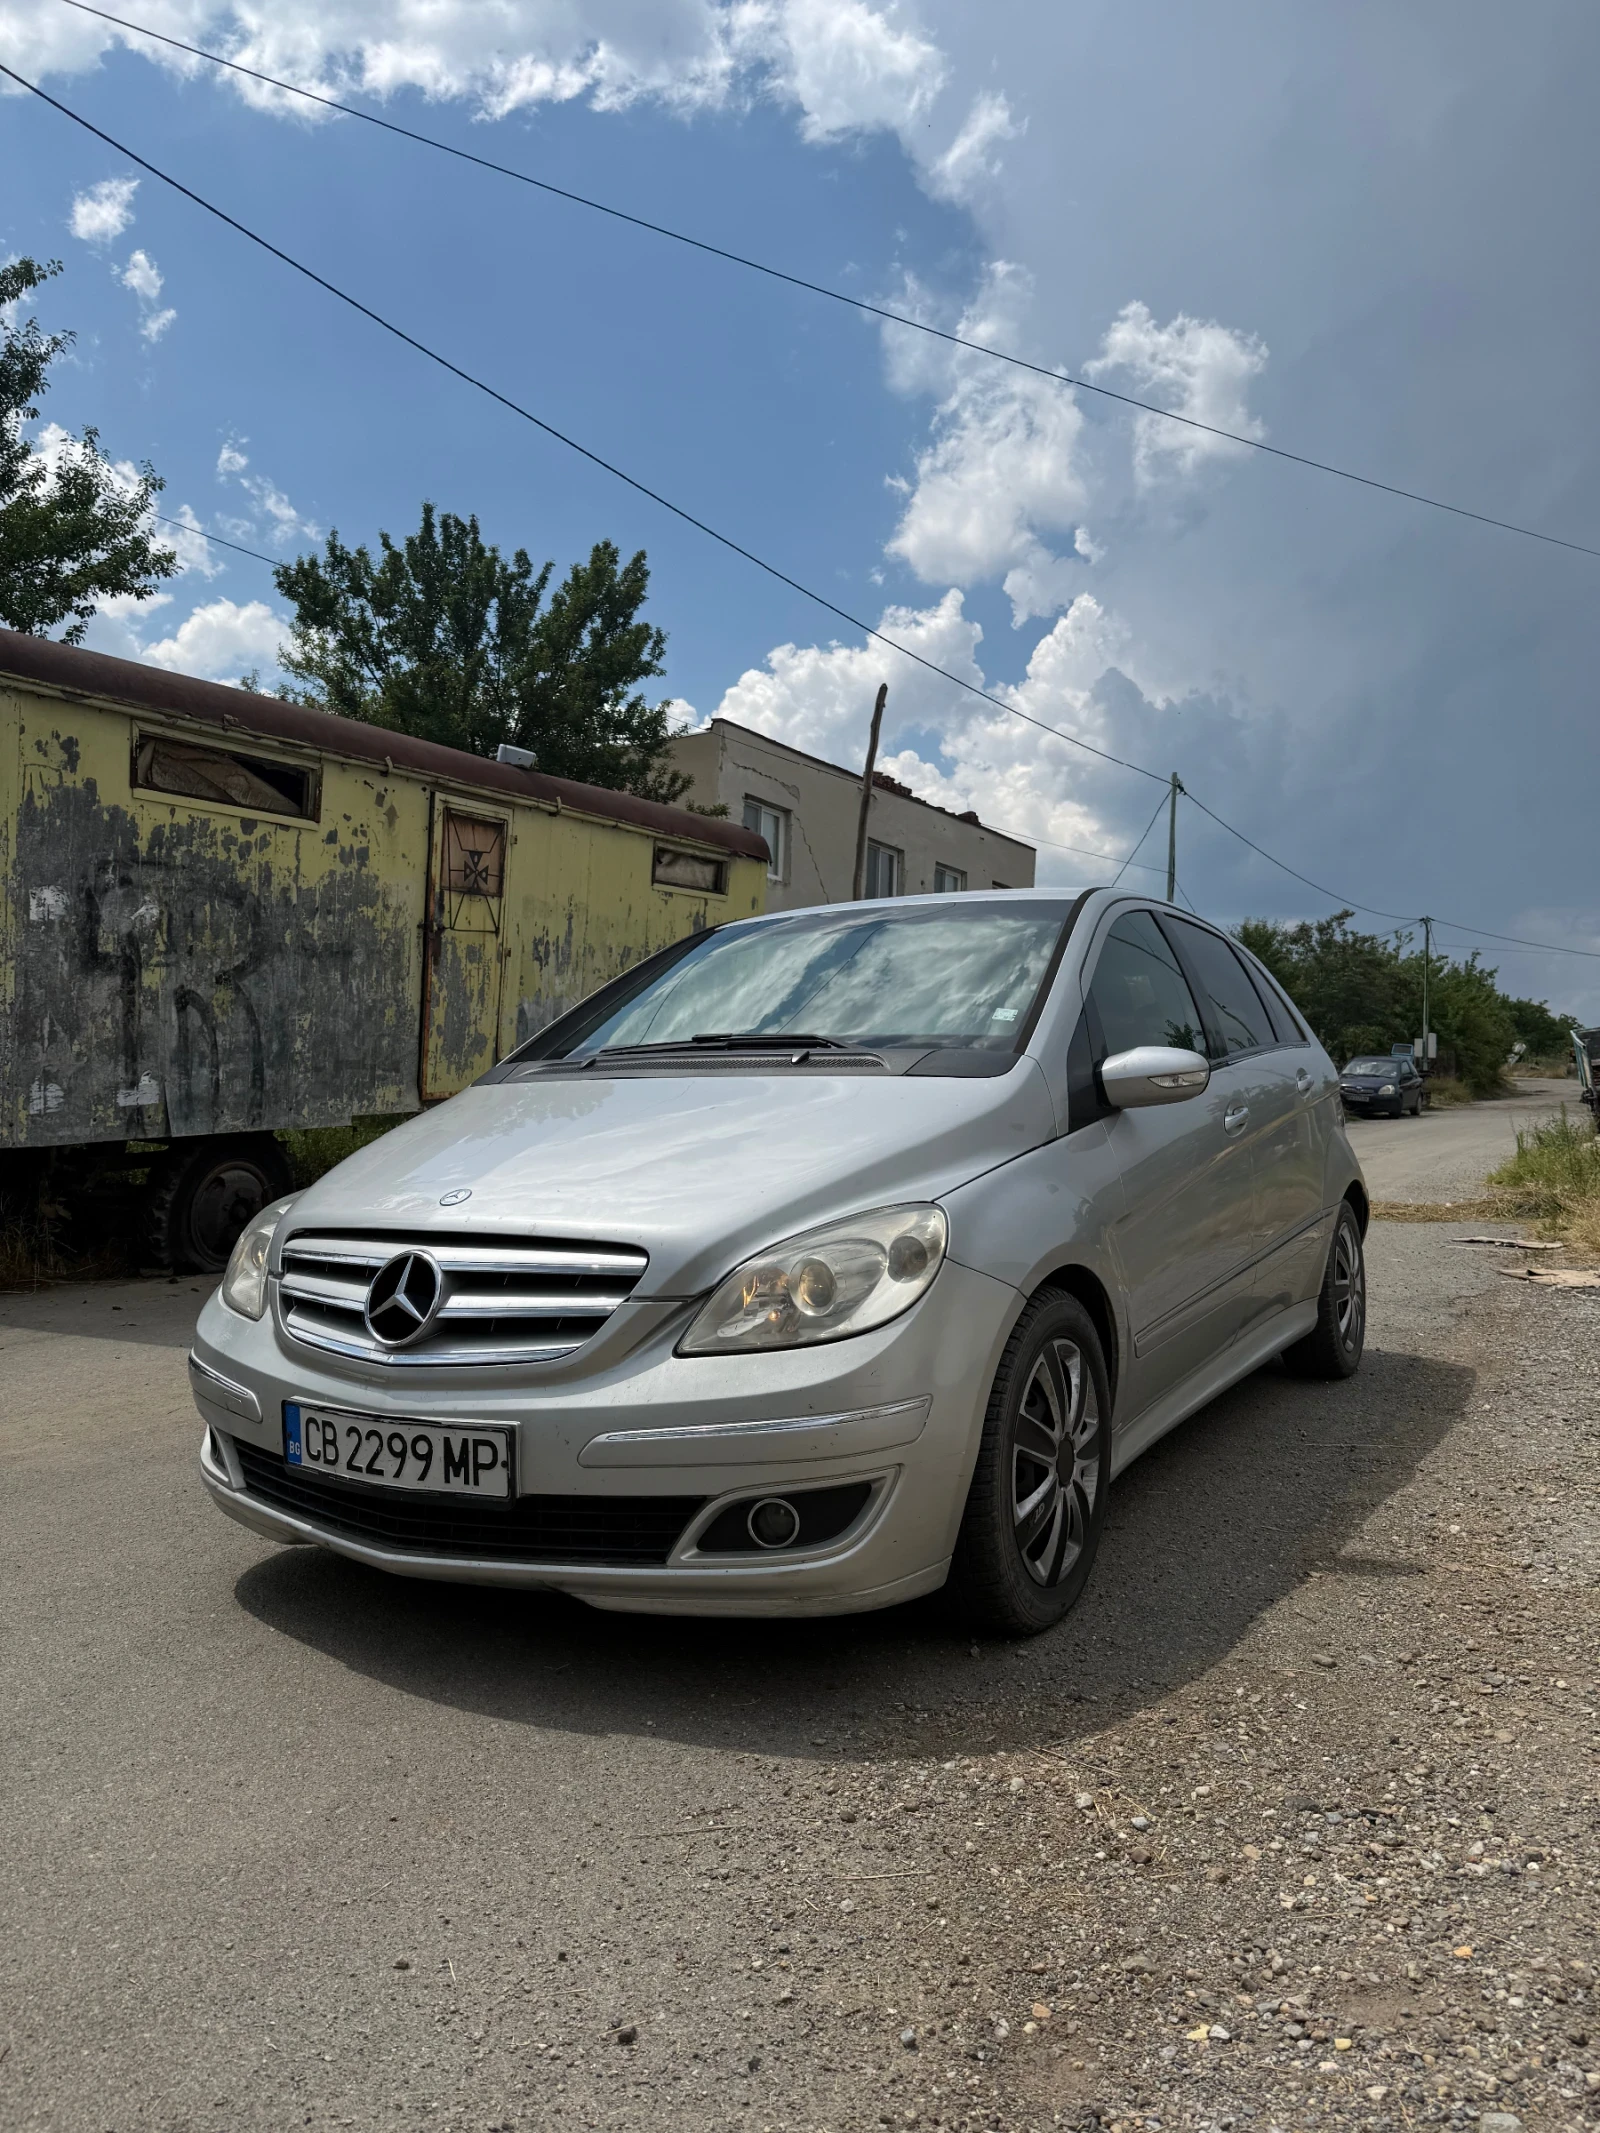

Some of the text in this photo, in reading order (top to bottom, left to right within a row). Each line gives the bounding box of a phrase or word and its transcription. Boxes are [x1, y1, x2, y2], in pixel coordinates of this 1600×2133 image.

[289, 1441, 301, 1455] BG
[305, 1416, 498, 1486] CB 2299 MP
